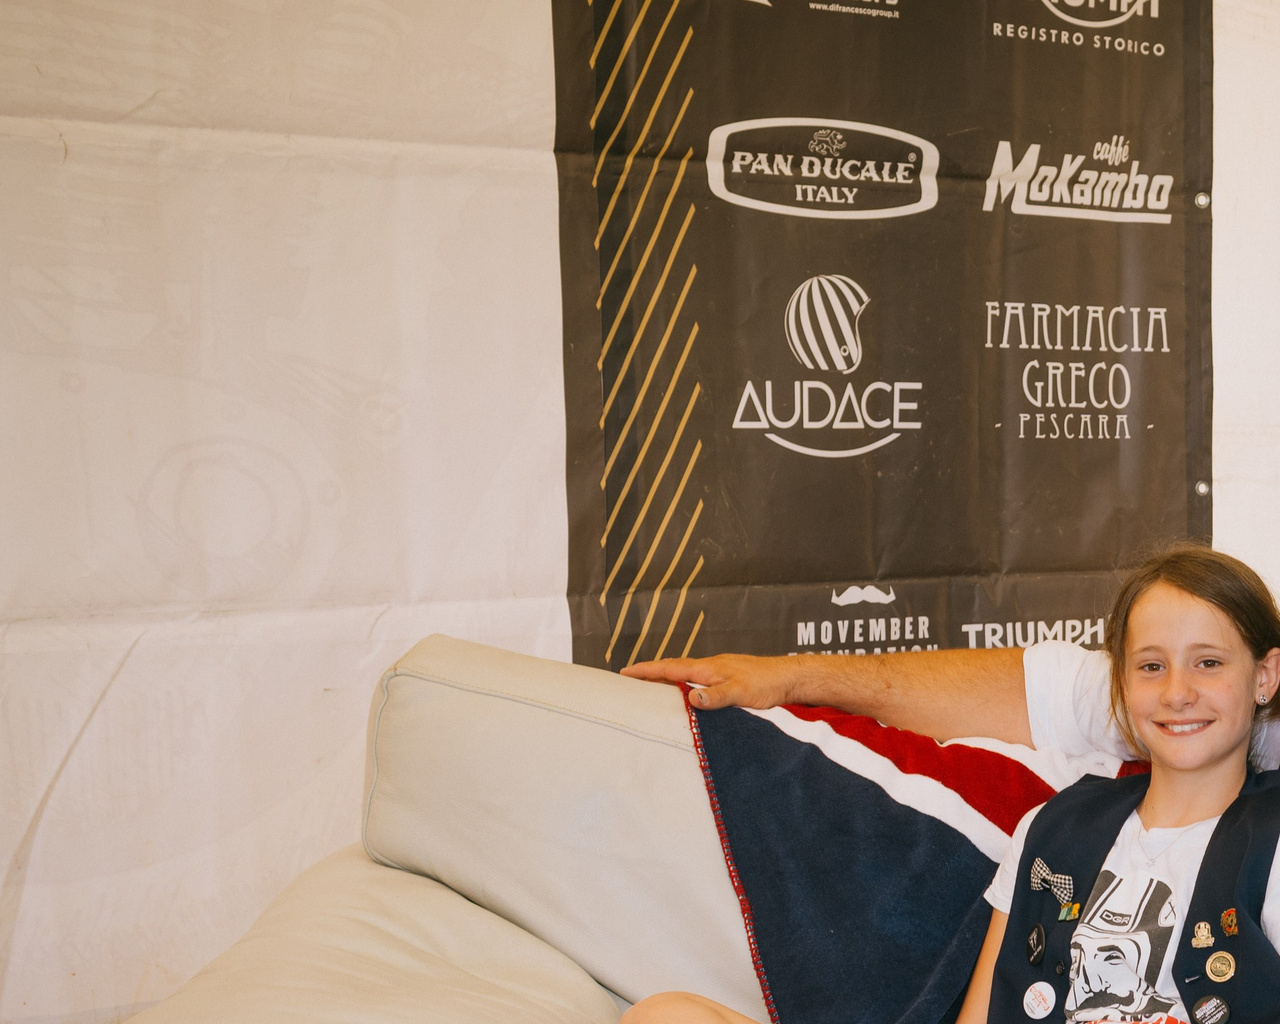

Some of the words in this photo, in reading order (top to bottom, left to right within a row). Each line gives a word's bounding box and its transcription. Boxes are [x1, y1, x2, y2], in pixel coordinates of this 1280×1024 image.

[809, 2, 900, 18] www.difrancescogroup.it
[993, 22, 1084, 46] REGISTRO
[1093, 35, 1166, 56] STORICO
[732, 151, 793, 177] PAN
[799, 156, 915, 184] DUCALE
[795, 184, 858, 204] ITALY
[985, 301, 1170, 353] FARMACIA
[1022, 359, 1132, 409] GRECO
[732, 381, 923, 430] AUDACE
[1018, 413, 1131, 439] PESCARA
[797, 616, 930, 646] MOVEMBER
[962, 618, 1105, 649] TRIUMPH
[1102, 910, 1131, 925] DGR
